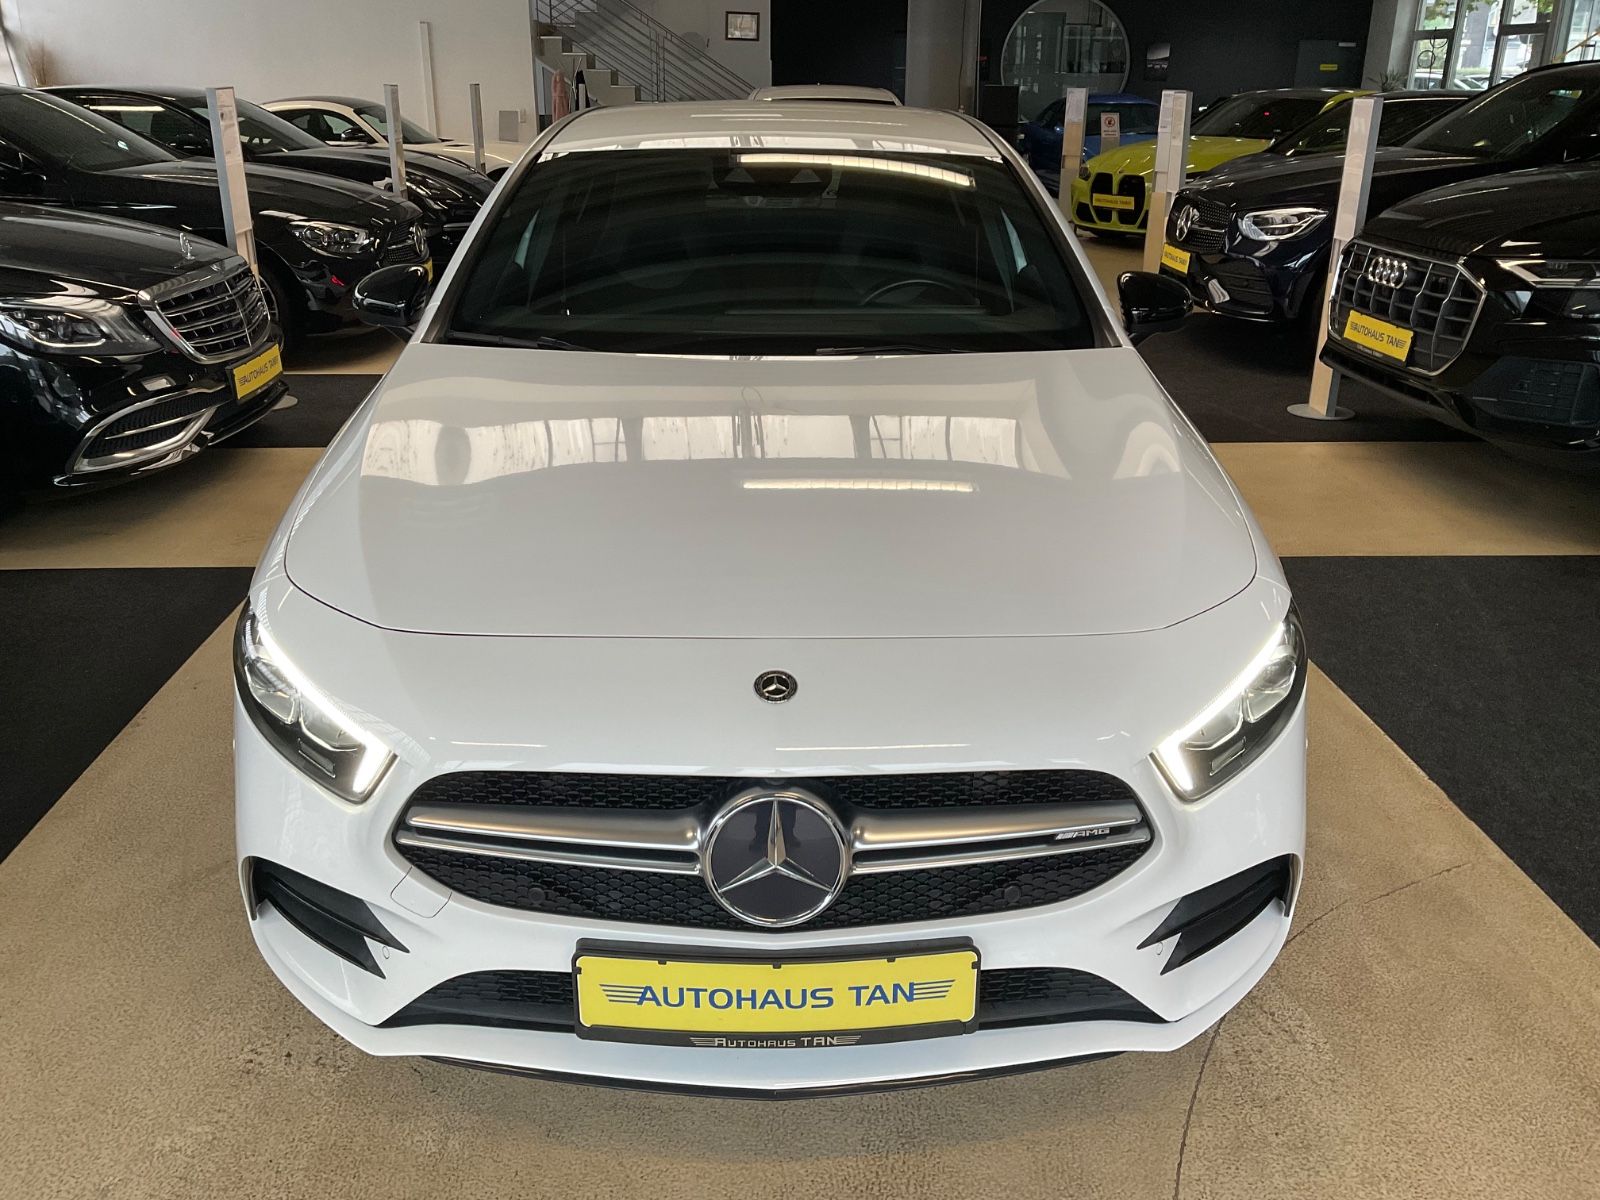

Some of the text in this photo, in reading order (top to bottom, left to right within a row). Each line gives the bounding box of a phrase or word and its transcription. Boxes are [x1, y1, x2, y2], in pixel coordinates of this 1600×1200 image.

[1355, 322, 1401, 349] AUTOHAUS TAN
[636, 982, 914, 1010] AUTOHAUS TAN
[801, 1036, 837, 1047] TAN
